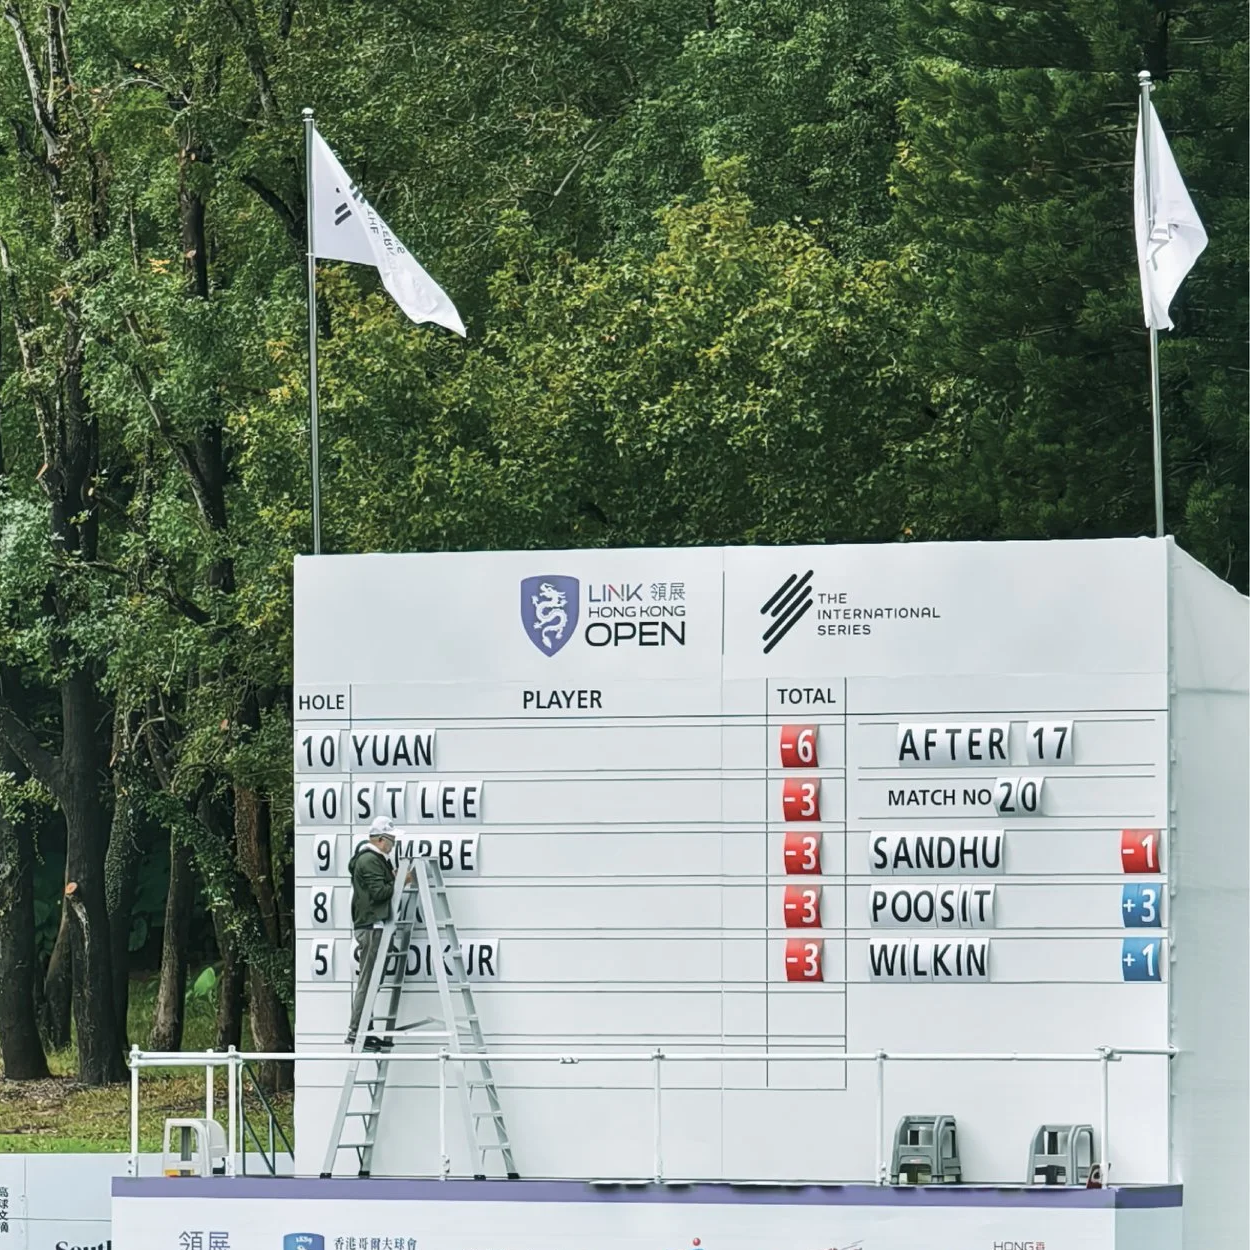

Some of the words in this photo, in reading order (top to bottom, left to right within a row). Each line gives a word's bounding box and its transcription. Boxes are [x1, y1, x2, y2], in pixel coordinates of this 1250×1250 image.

[589, 584, 643, 602] LINK
[650, 583, 686, 601] 領展
[817, 593, 848, 604] THE
[589, 606, 637, 618] HONG
[640, 605, 686, 617] KONG
[817, 607, 941, 620] INTERNATIONAL
[585, 621, 686, 646] OPEN
[817, 624, 871, 636] SERIES
[299, 695, 345, 710] HOLE
[523, 690, 603, 710] PLAYER
[777, 688, 836, 705] TOTAL
[302, 735, 335, 767] 10
[352, 735, 432, 766] YUAN
[782, 729, 813, 763] -6
[899, 728, 1007, 761] AFTER
[1032, 727, 1068, 760] 17
[305, 787, 337, 819] 10
[421, 787, 477, 818] LEE
[784, 783, 816, 816] -3
[888, 790, 955, 806] MATCH
[963, 789, 992, 805] NO
[1000, 781, 1037, 812] 20
[317, 840, 331, 871] 9
[785, 836, 817, 870] -3
[874, 836, 1001, 869] SANDHU
[1122, 835, 1154, 868] -1
[314, 892, 328, 923] 8
[785, 890, 817, 923] -3
[873, 890, 991, 923] POOSIT
[1123, 888, 1156, 923] +3
[315, 944, 328, 976] 5
[786, 943, 818, 976] -3
[870, 943, 986, 977] WILKIN
[1123, 943, 1154, 976] +1
